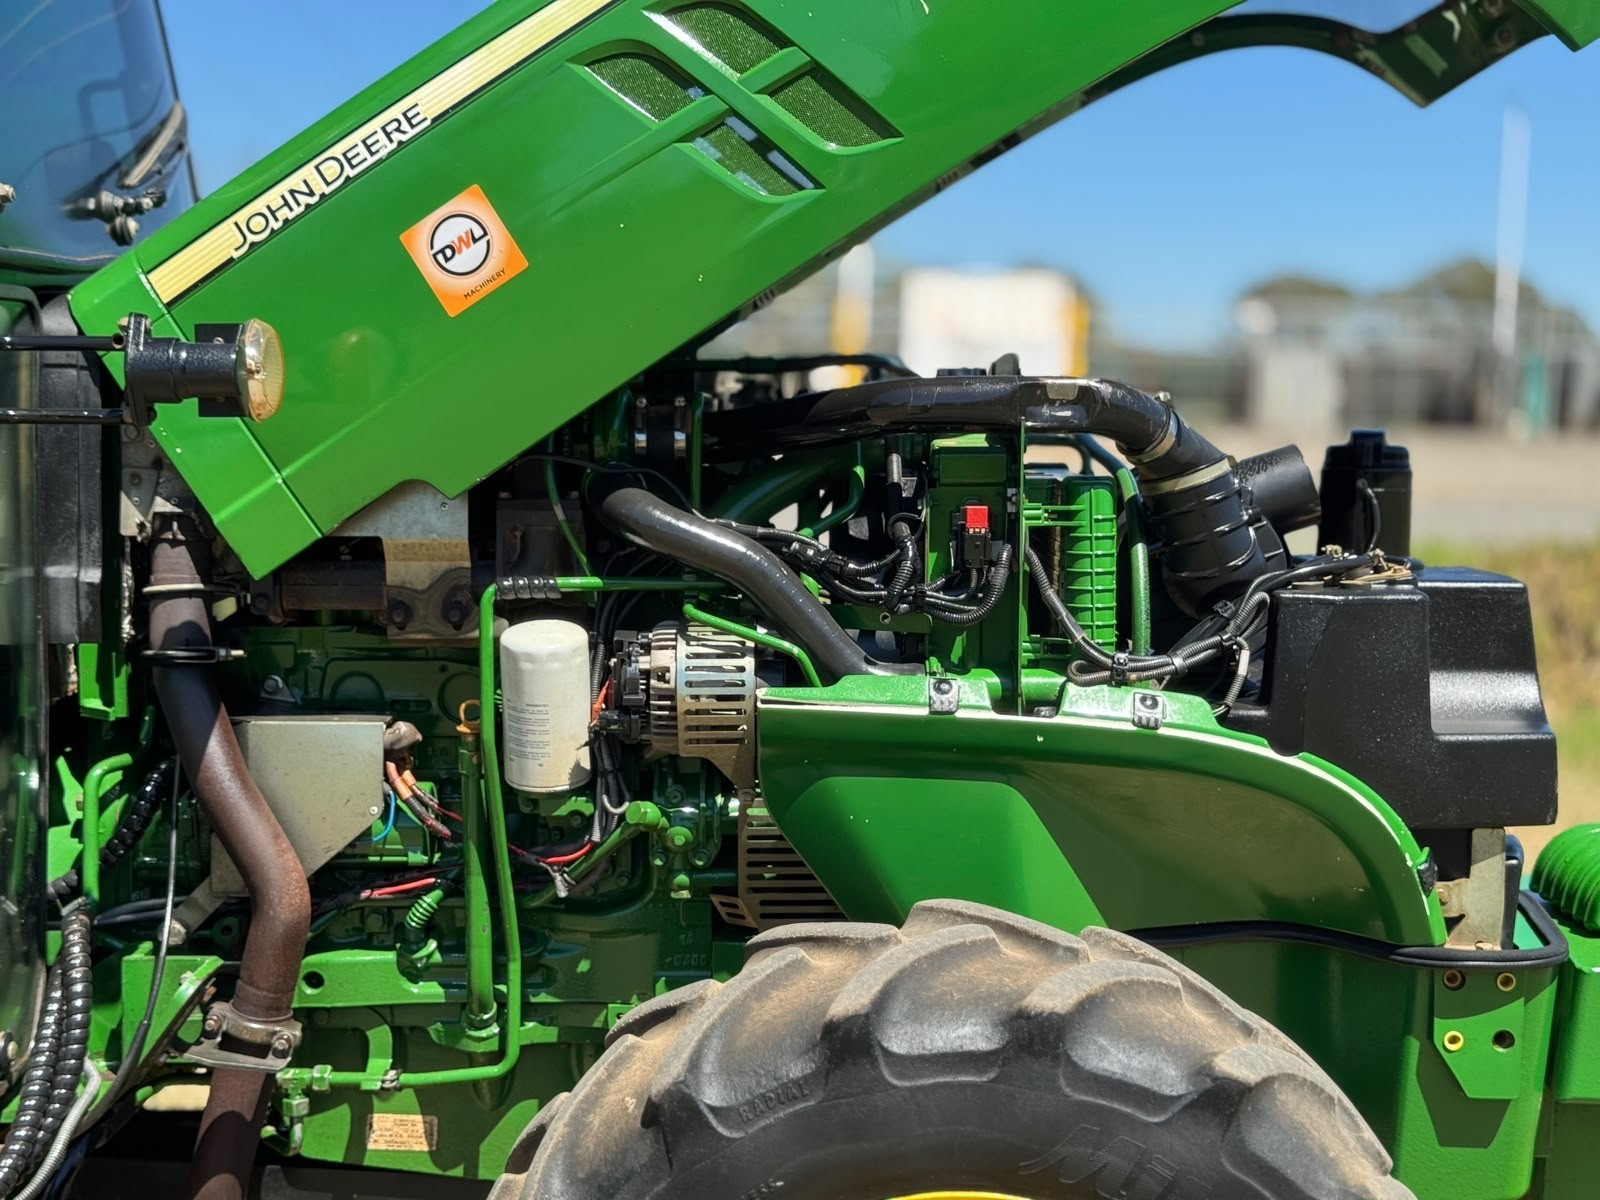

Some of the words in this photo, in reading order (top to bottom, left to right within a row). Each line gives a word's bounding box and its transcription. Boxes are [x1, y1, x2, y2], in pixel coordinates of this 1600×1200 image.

[232, 178, 317, 252] JOHN
[313, 103, 429, 186] DEERE
[431, 228, 489, 265] DWL
[463, 268, 506, 300] MACHINERY
[737, 1078, 808, 1114] RADIAL
